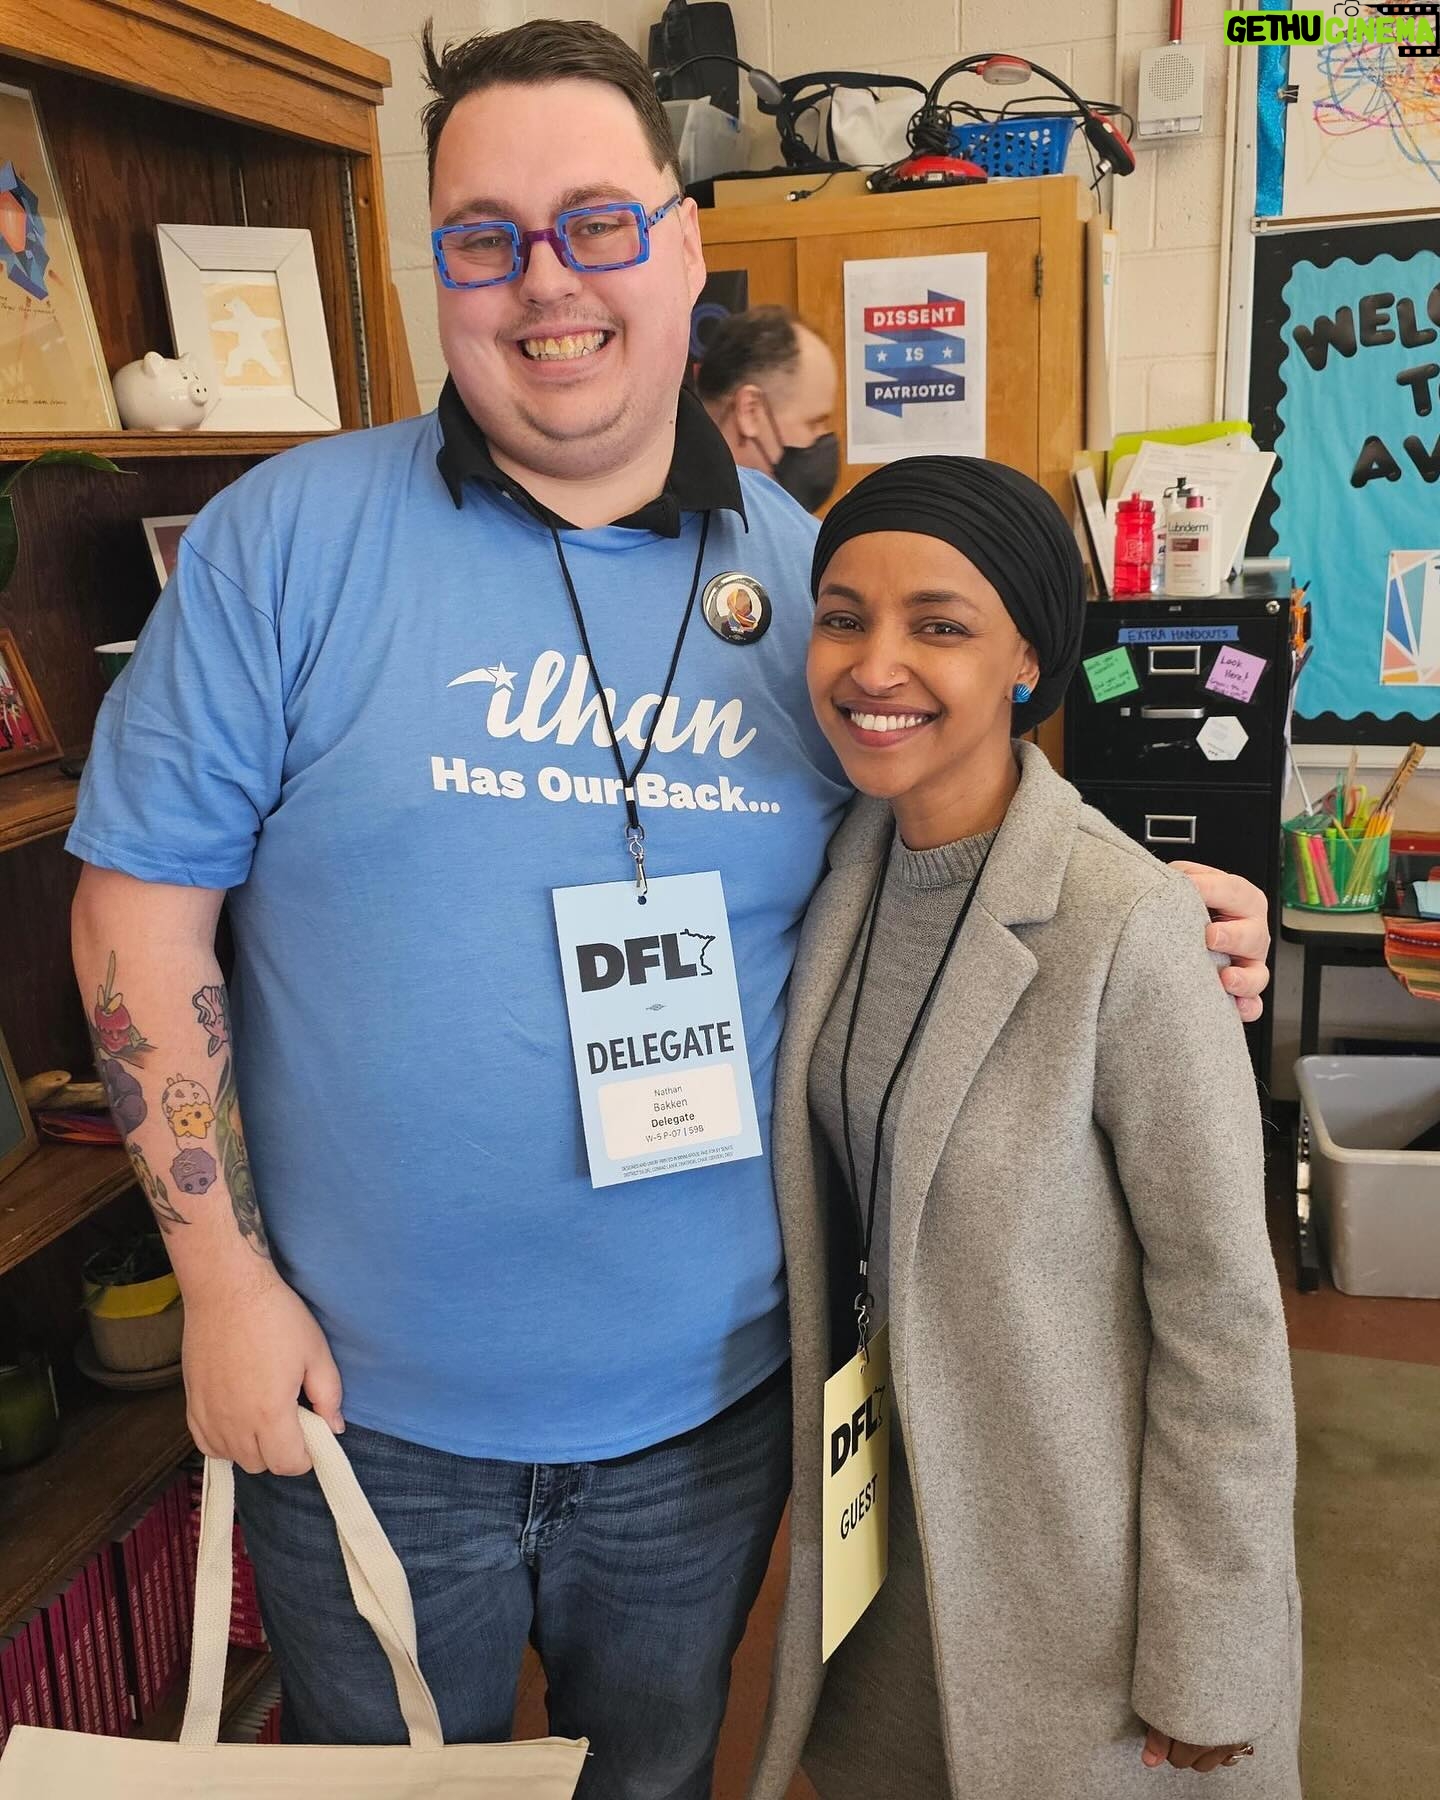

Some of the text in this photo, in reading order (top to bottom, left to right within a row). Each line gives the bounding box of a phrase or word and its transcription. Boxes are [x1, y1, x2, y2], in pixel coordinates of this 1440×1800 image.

[873, 307, 955, 327] DISSENT
[905, 347, 924, 362] IS
[874, 384, 956, 400] PATRIOTIC
[1128, 629, 1229, 641] EXTRA HANDOUTS
[431, 756, 526, 799] Has
[538, 767, 626, 805] Our
[576, 932, 698, 992] DFL
[587, 1021, 734, 1075] DELEGATE
[654, 1086, 683, 1096] Nathan
[653, 1098, 688, 1112] Bakken
[651, 1113, 695, 1128] Delegate
[831, 1394, 878, 1478] DFL
[841, 1473, 878, 1540] GUEST
